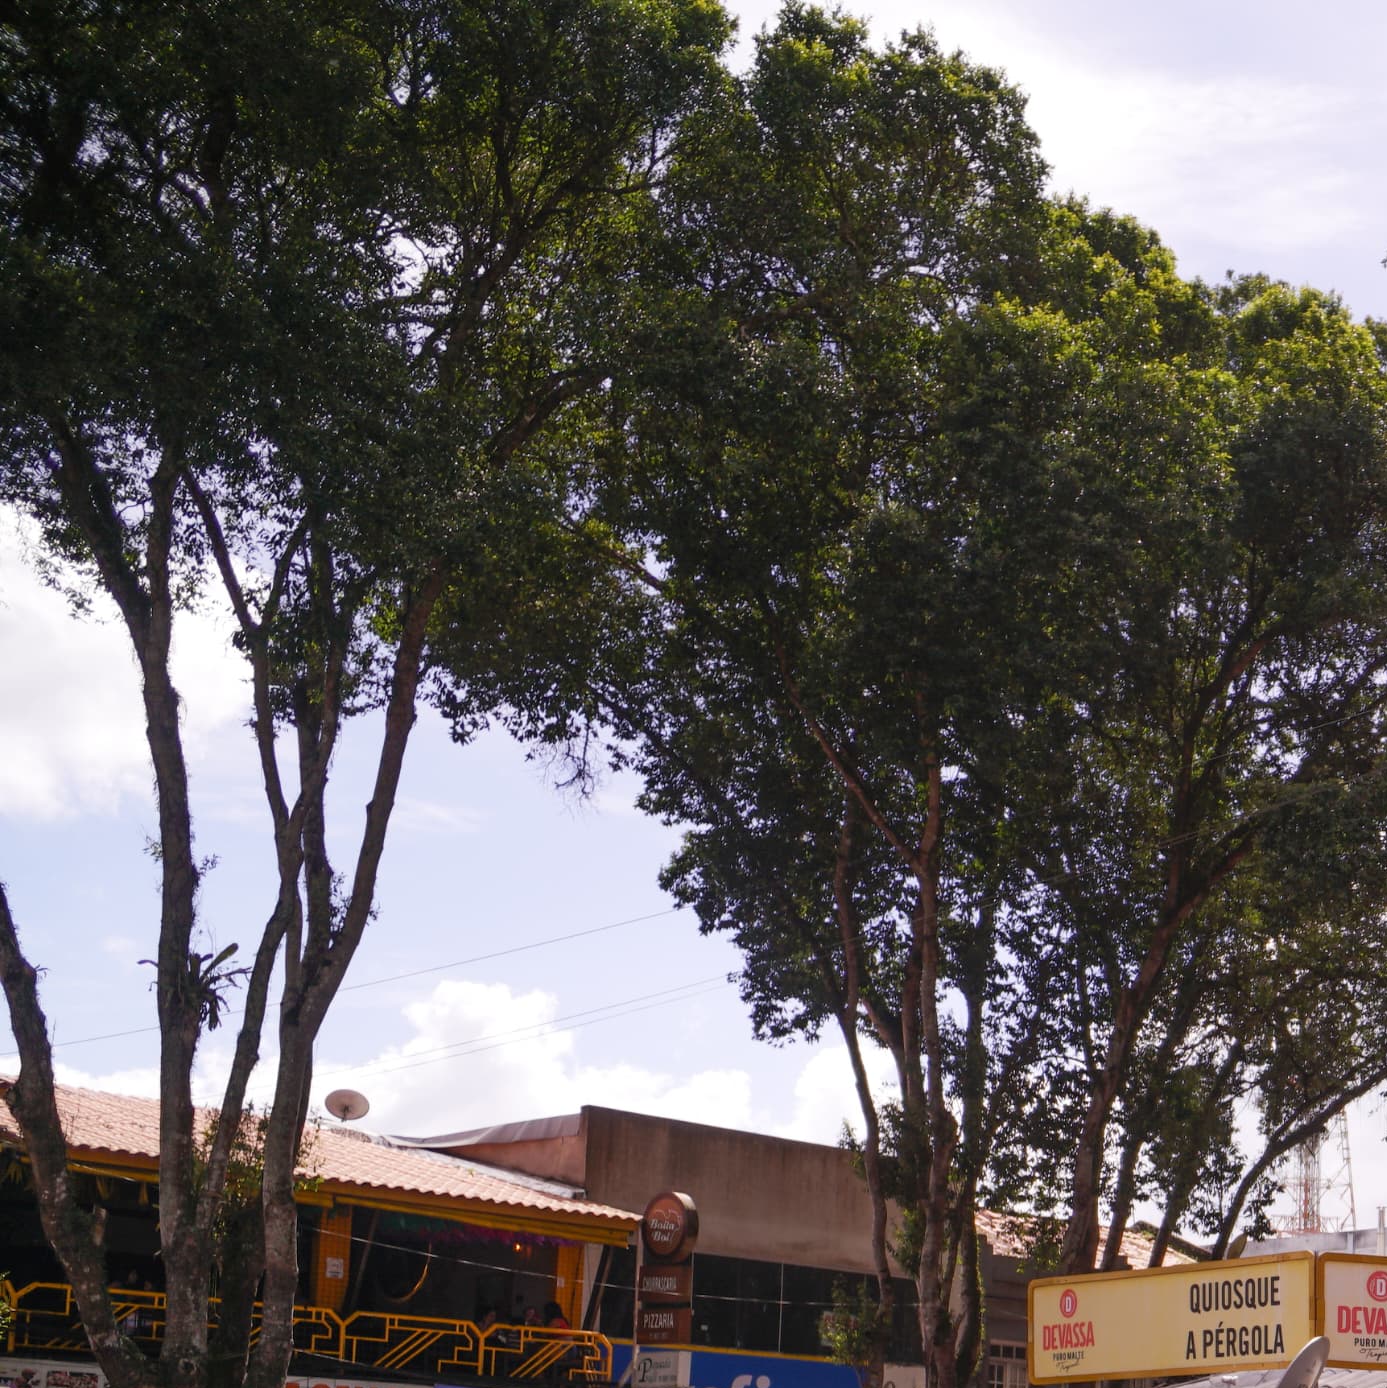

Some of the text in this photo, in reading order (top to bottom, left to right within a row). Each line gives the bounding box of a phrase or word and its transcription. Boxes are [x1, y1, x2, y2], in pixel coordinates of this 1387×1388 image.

[1189, 1276, 1281, 1314] QUIOSQUE
[643, 1313, 674, 1329] PIZZARIA
[1042, 1321, 1095, 1351] DEVASSA
[1186, 1322, 1285, 1360] A PÉRGOLA
[1354, 1337, 1377, 1349] PURO
